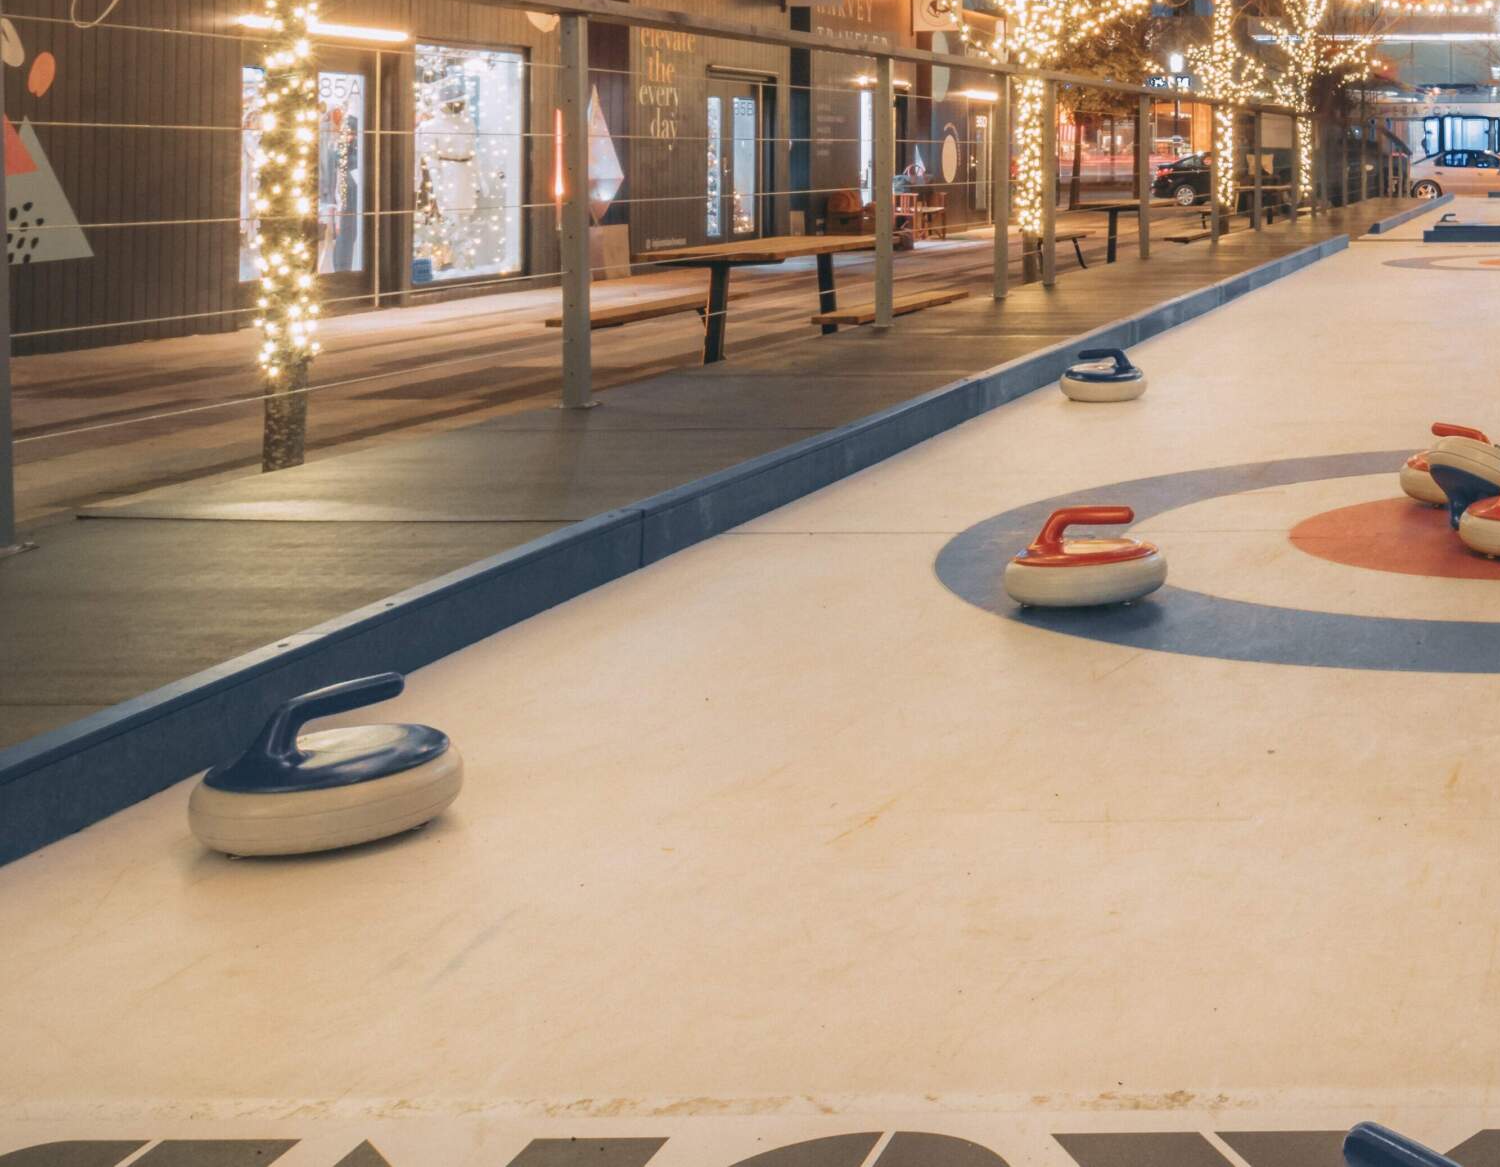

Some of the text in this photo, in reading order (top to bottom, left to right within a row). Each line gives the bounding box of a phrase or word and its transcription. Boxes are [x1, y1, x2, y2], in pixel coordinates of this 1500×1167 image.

[647, 50, 675, 83] the
[319, 76, 361, 99] 85A
[639, 84, 680, 117] every
[650, 107, 679, 151] day
